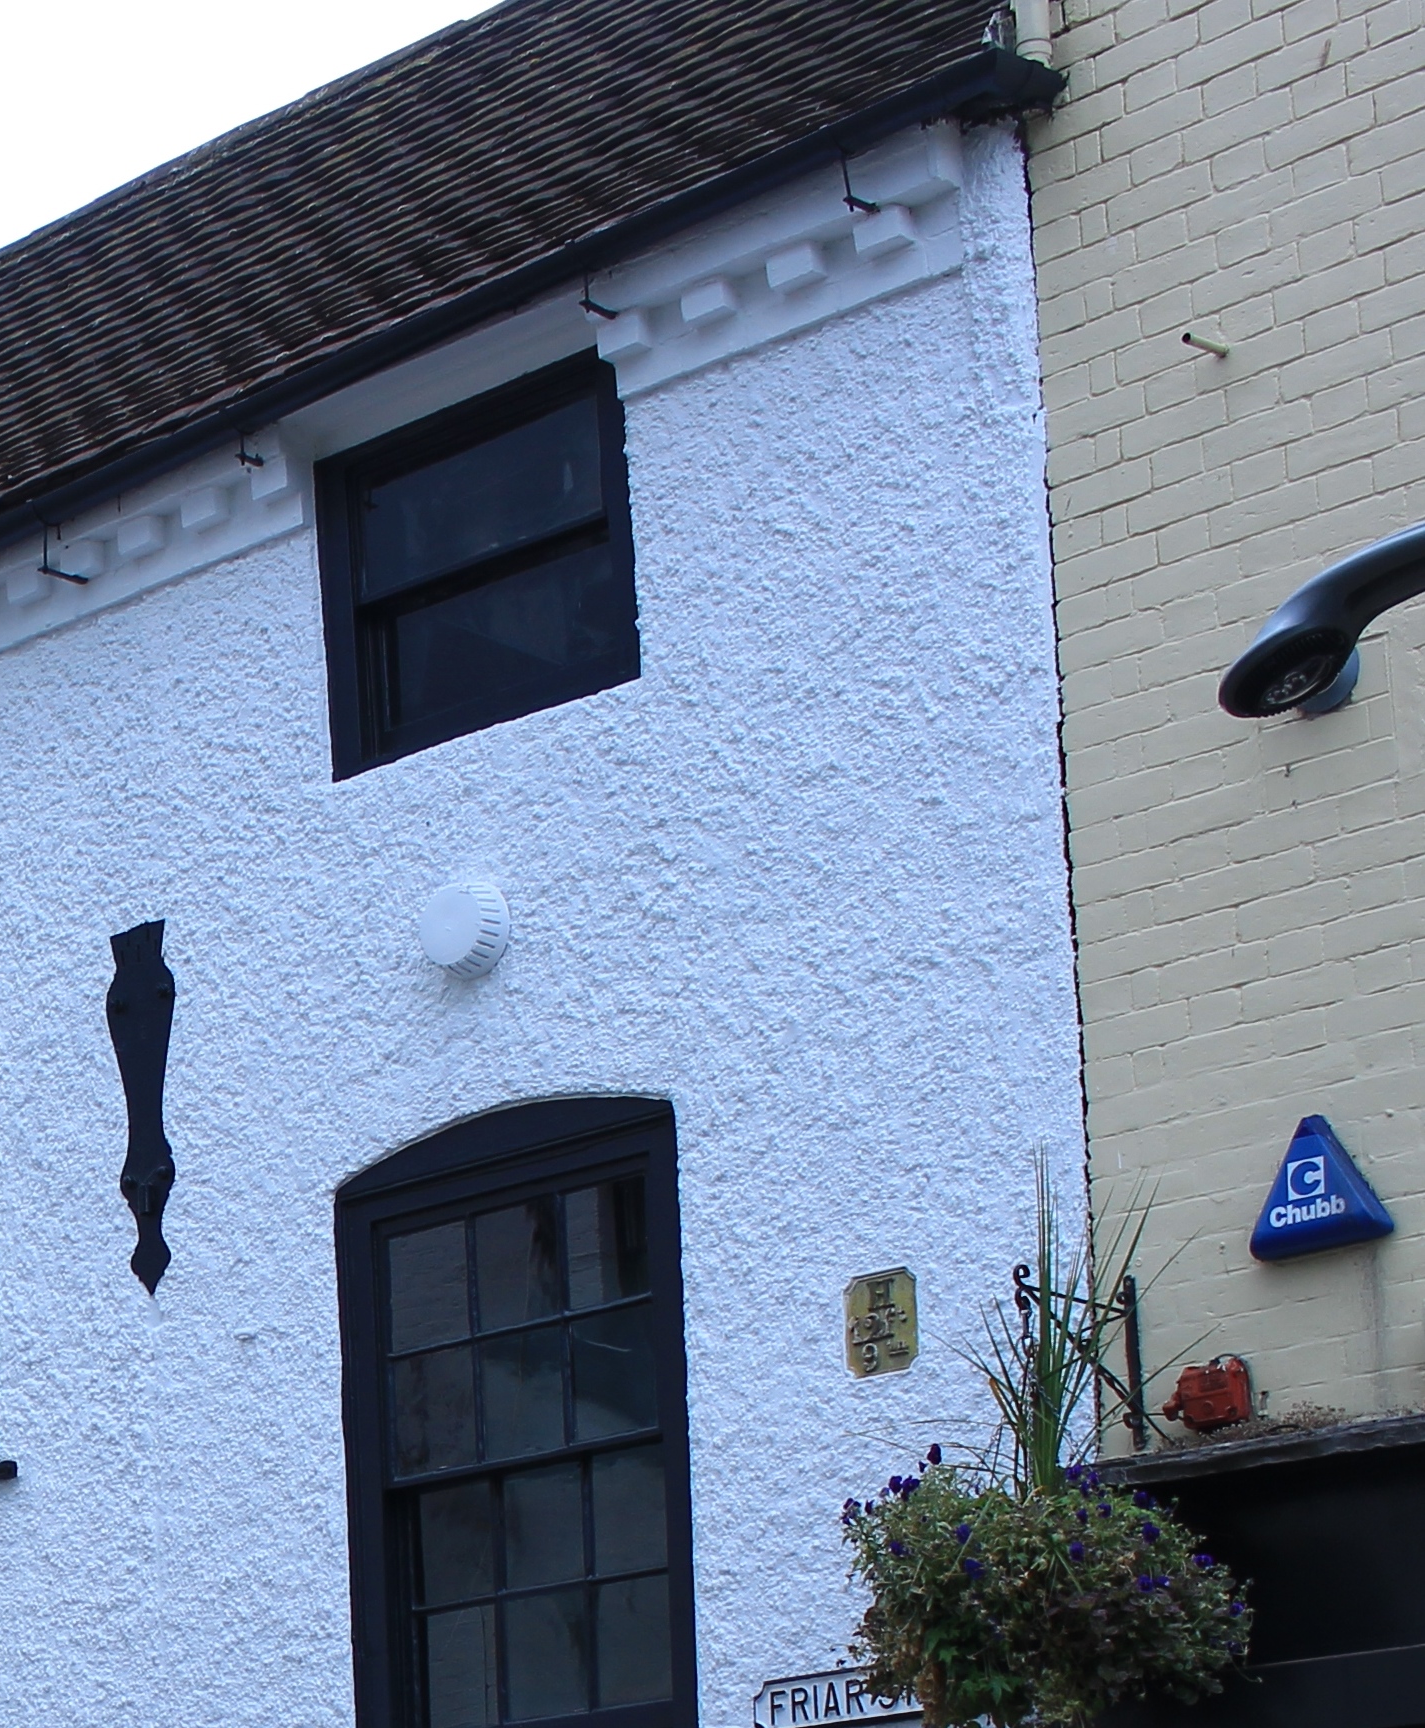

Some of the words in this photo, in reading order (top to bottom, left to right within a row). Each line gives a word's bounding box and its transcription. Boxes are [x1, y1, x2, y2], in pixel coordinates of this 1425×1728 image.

[1269, 1194, 1346, 1228] Chubb
[862, 1342, 878, 1372] 9
[769, 1678, 865, 1727] FRIAR
